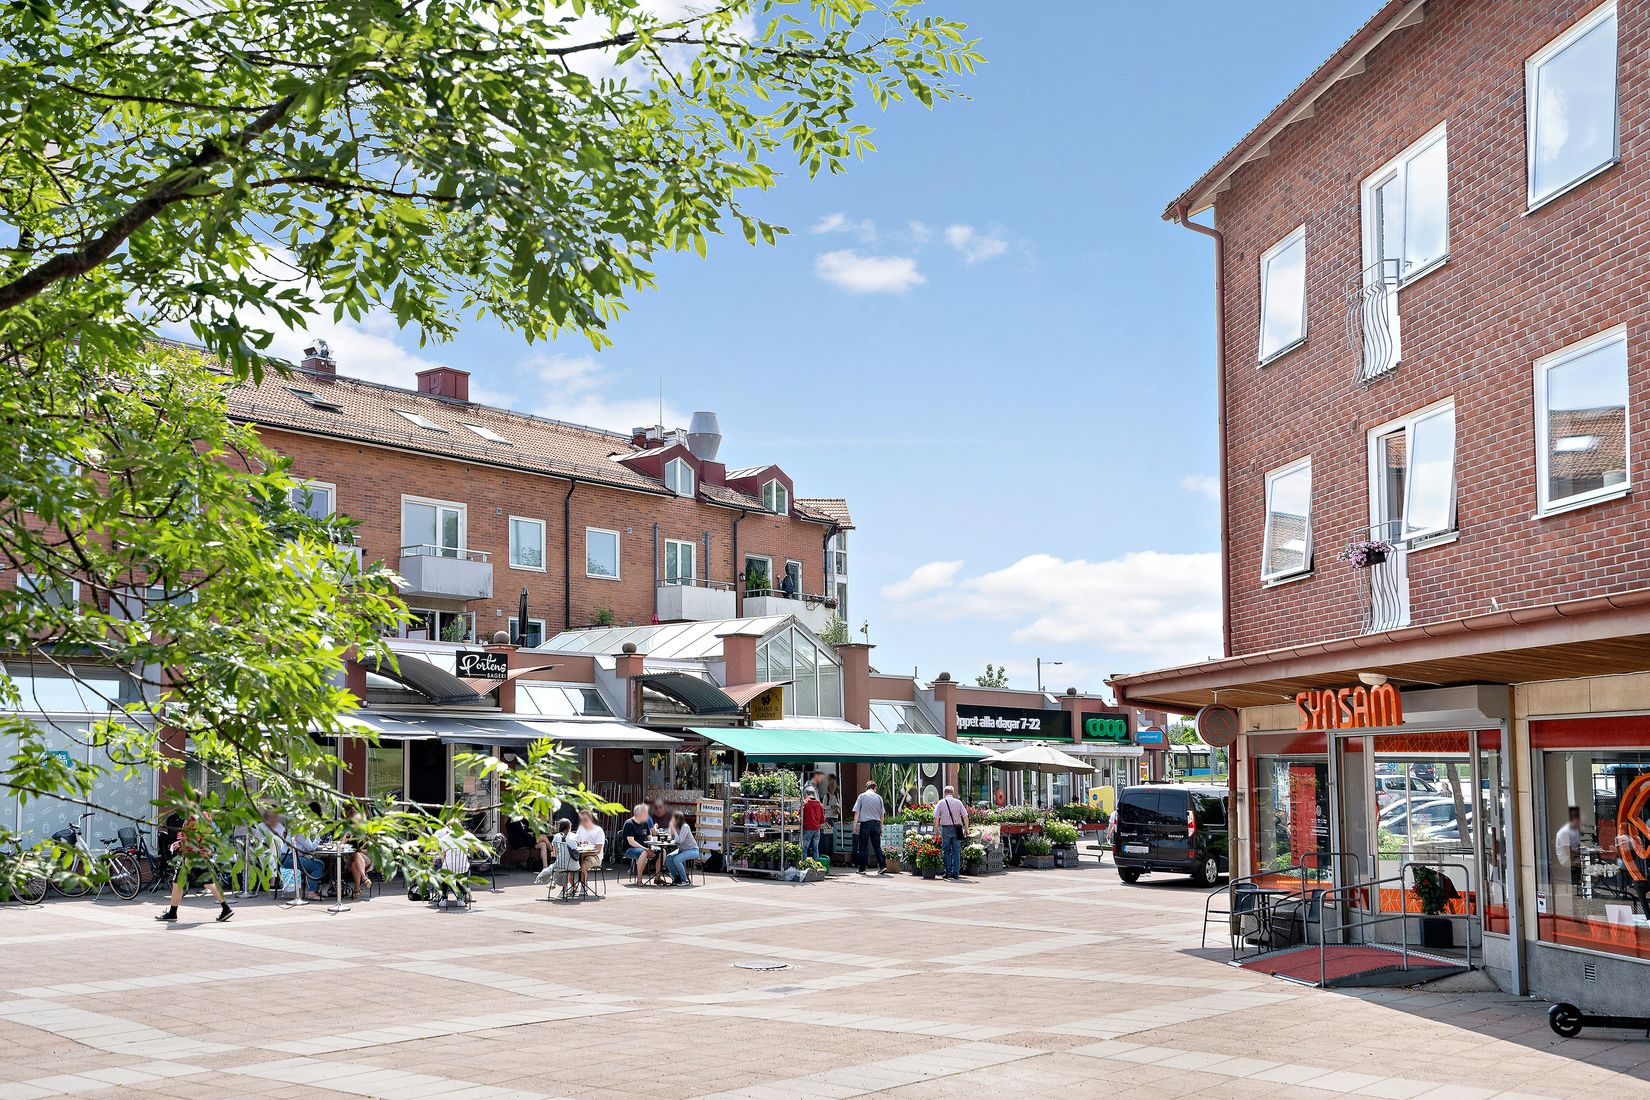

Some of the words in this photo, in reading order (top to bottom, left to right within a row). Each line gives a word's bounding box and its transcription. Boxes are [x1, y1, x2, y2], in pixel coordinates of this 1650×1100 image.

[459, 653, 507, 677] Portens
[1296, 683, 1402, 730] SYNSAM
[979, 715, 996, 728] alla
[996, 716, 1020, 732] dagar
[1020, 717, 1041, 731] 7-22
[1086, 718, 1127, 742] coop
